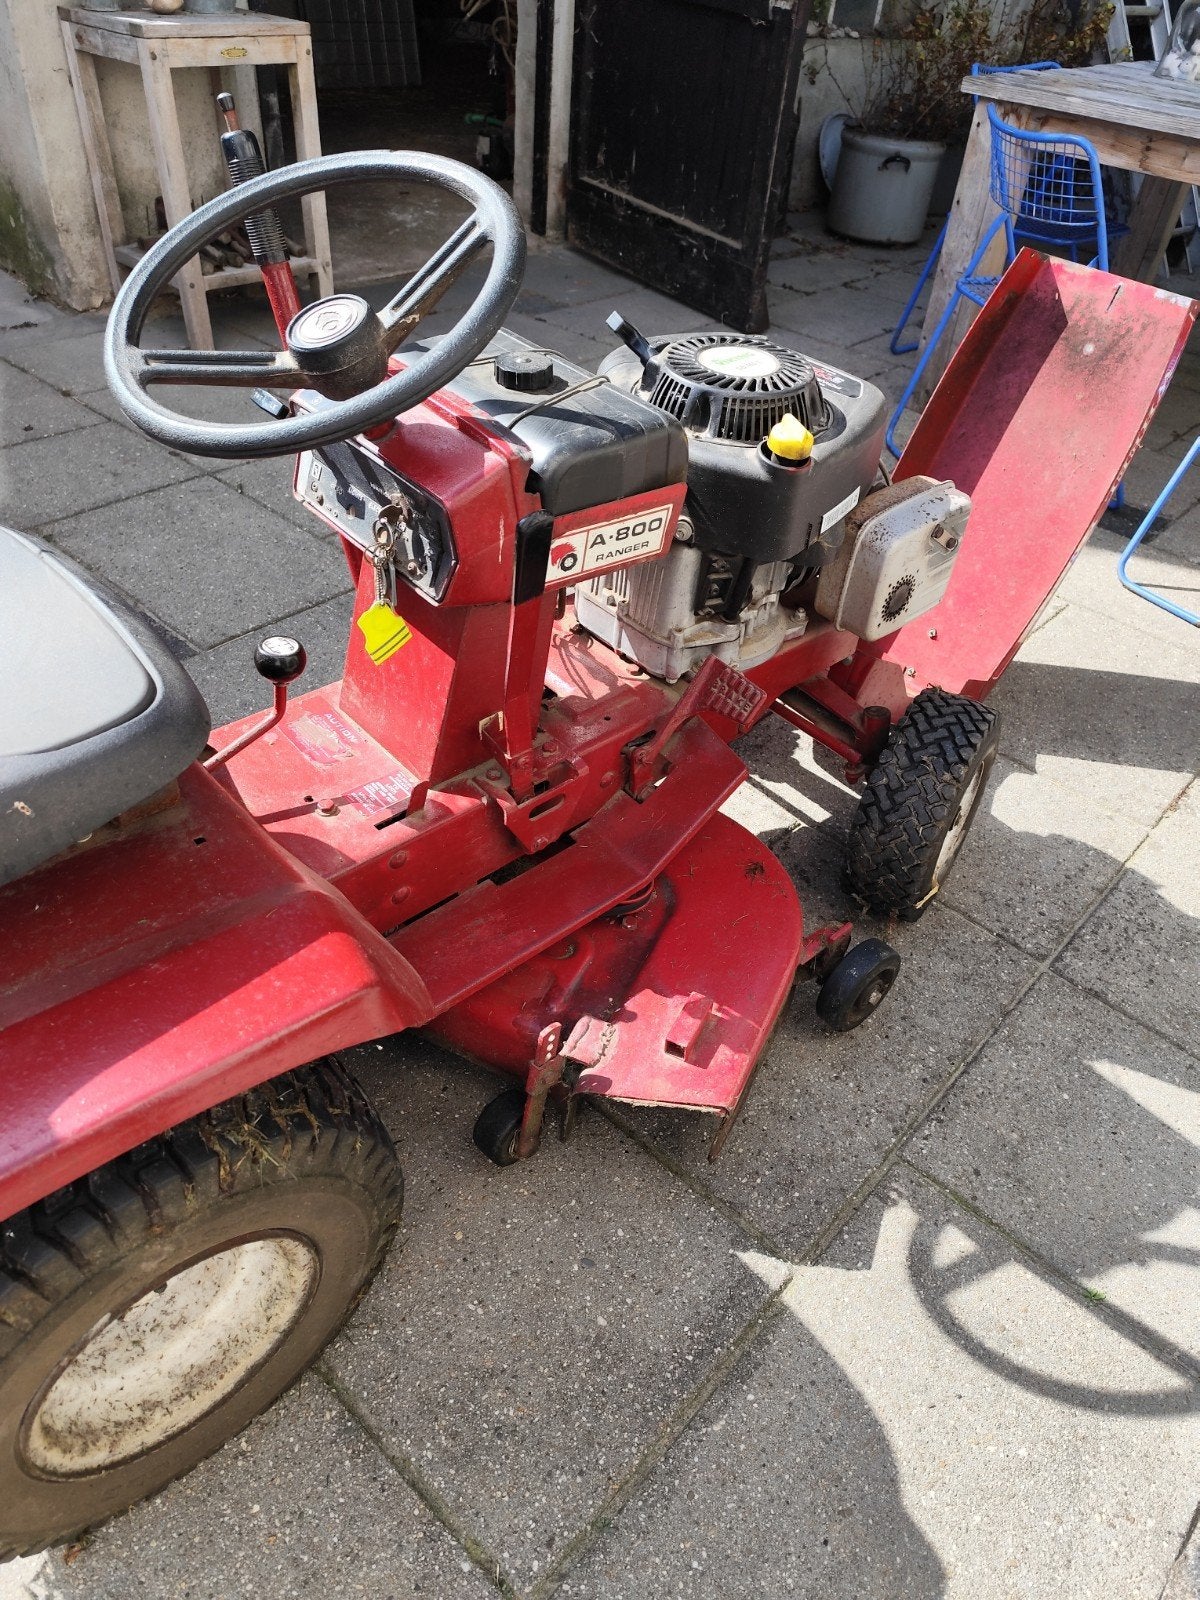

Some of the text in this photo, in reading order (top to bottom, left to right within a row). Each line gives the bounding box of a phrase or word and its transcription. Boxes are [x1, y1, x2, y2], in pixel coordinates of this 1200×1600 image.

[595, 540, 650, 562] RANGER
[711, 677, 755, 714] BRAKE
[323, 713, 359, 744] AUTION
